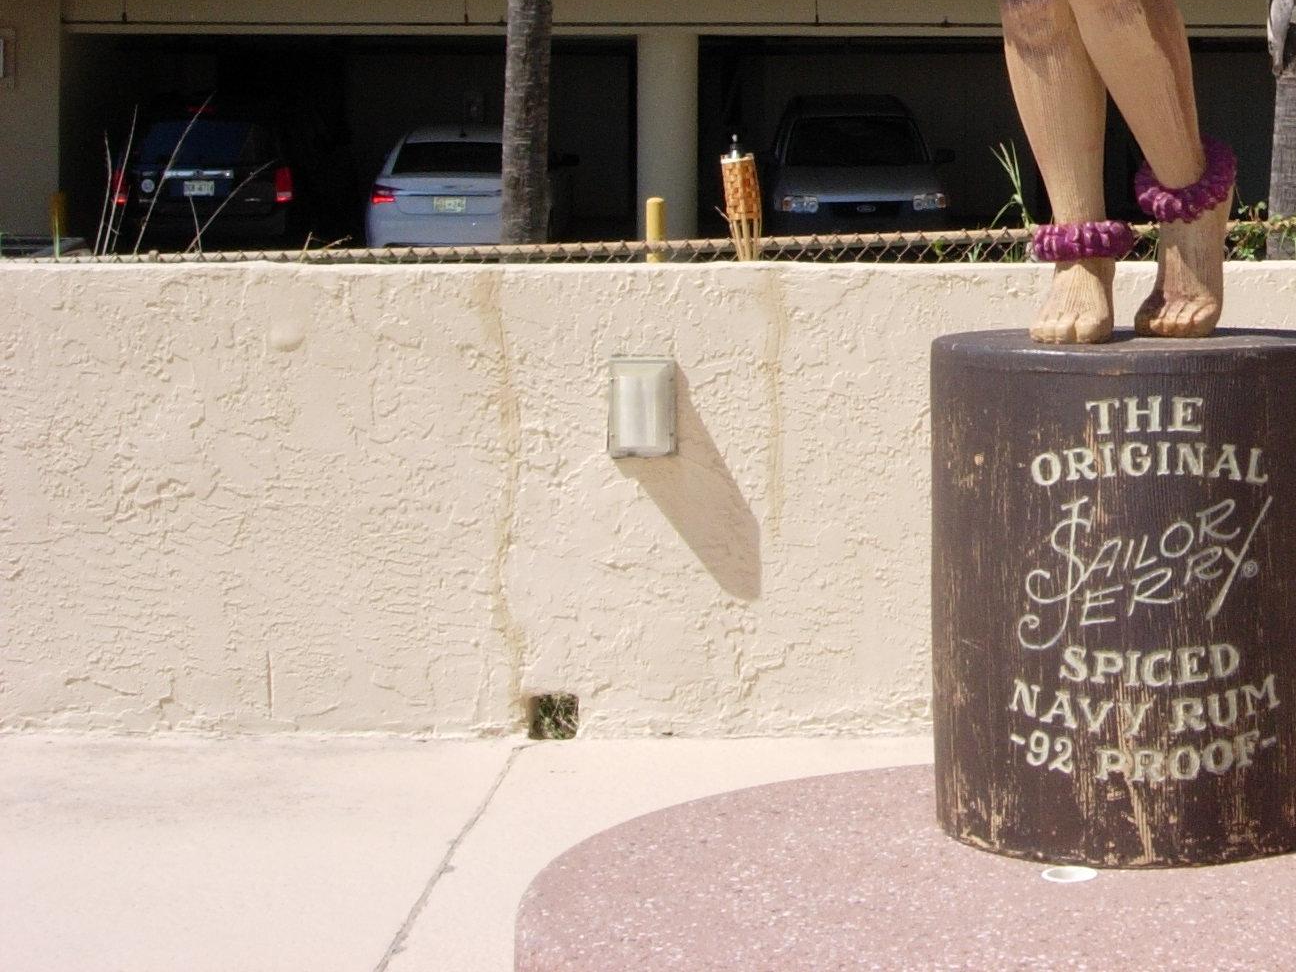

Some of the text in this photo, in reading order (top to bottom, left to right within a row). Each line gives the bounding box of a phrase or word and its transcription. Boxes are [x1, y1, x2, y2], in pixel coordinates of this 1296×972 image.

[1086, 395, 1203, 435] THE
[1031, 441, 1269, 486] ORIGINAL
[1058, 643, 1240, 687] SPICED
[1008, 674, 1281, 736] NAVY RUM
